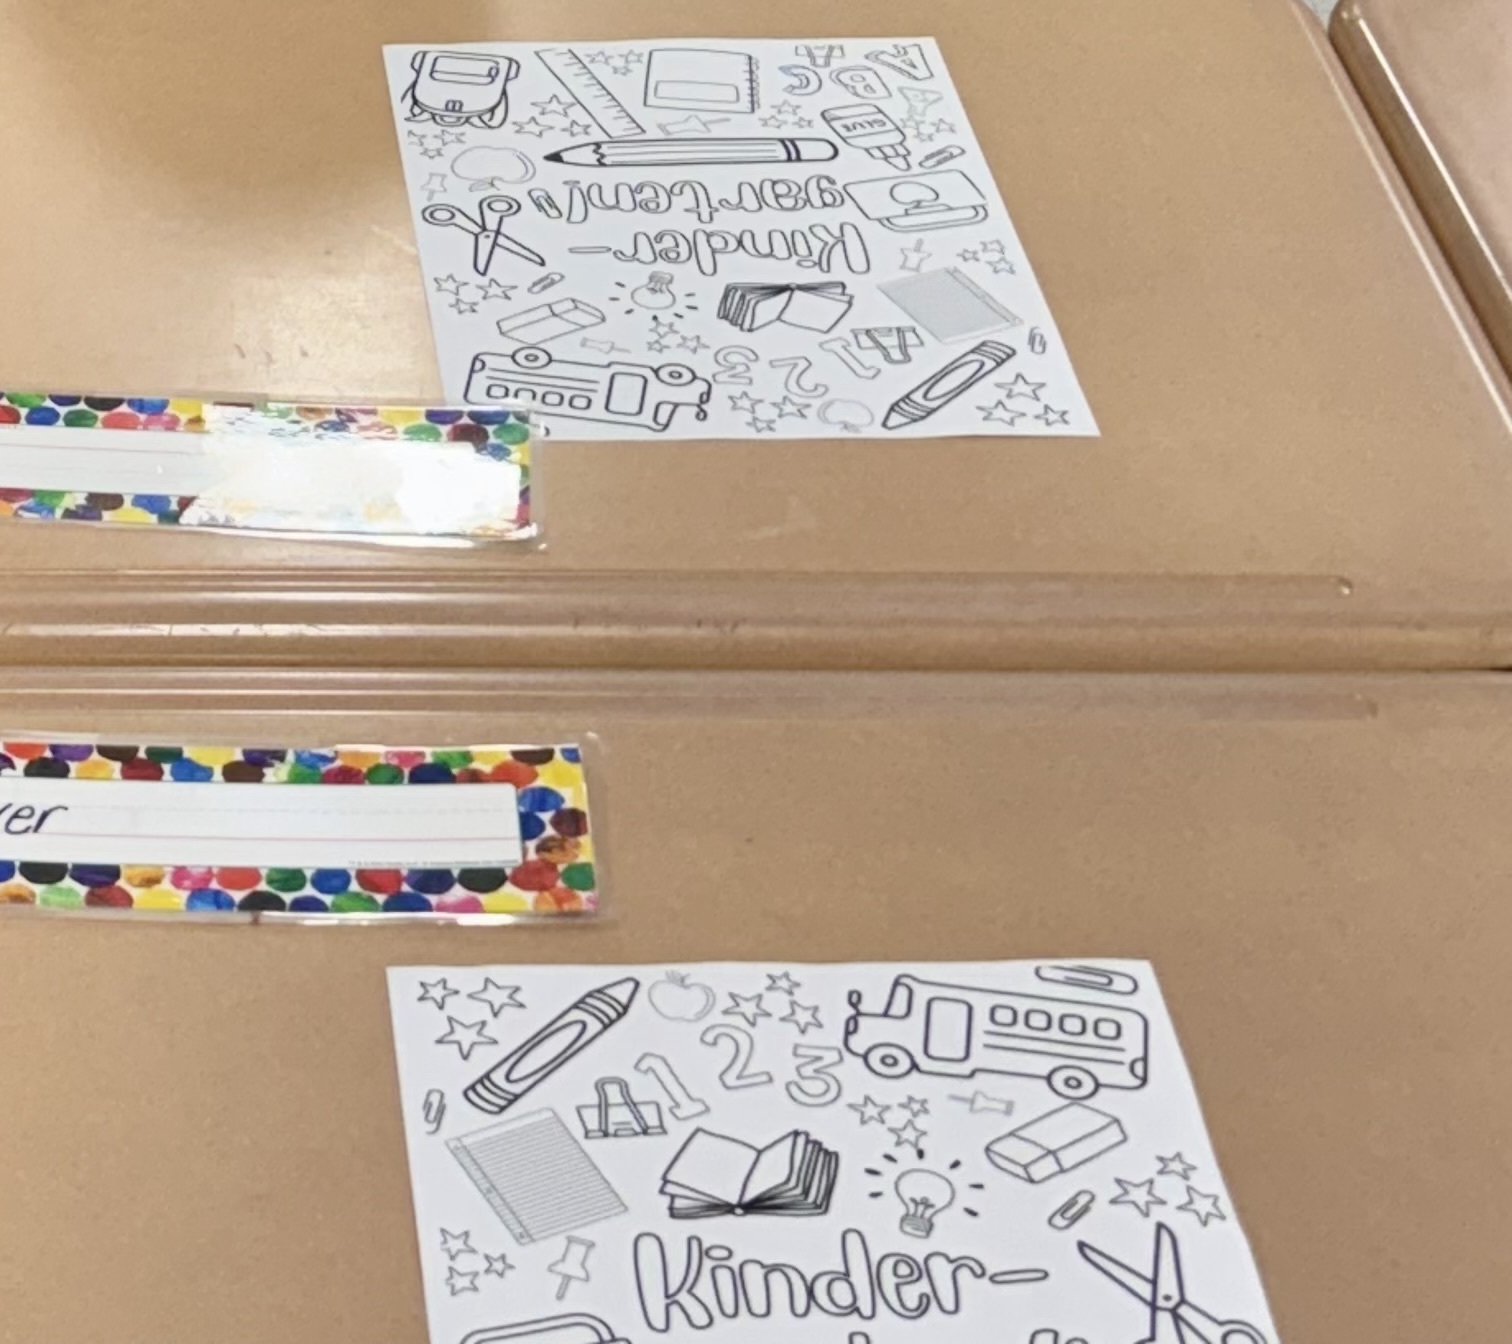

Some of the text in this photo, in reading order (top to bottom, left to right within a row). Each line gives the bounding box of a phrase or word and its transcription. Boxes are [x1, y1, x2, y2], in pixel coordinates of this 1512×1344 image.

[840, 118, 887, 133] GLUE
[712, 345, 759, 385] 3
[769, 356, 829, 398] 2
[634, 1024, 844, 1120] 1 2 3
[633, 1229, 1049, 1333] Kinder-
